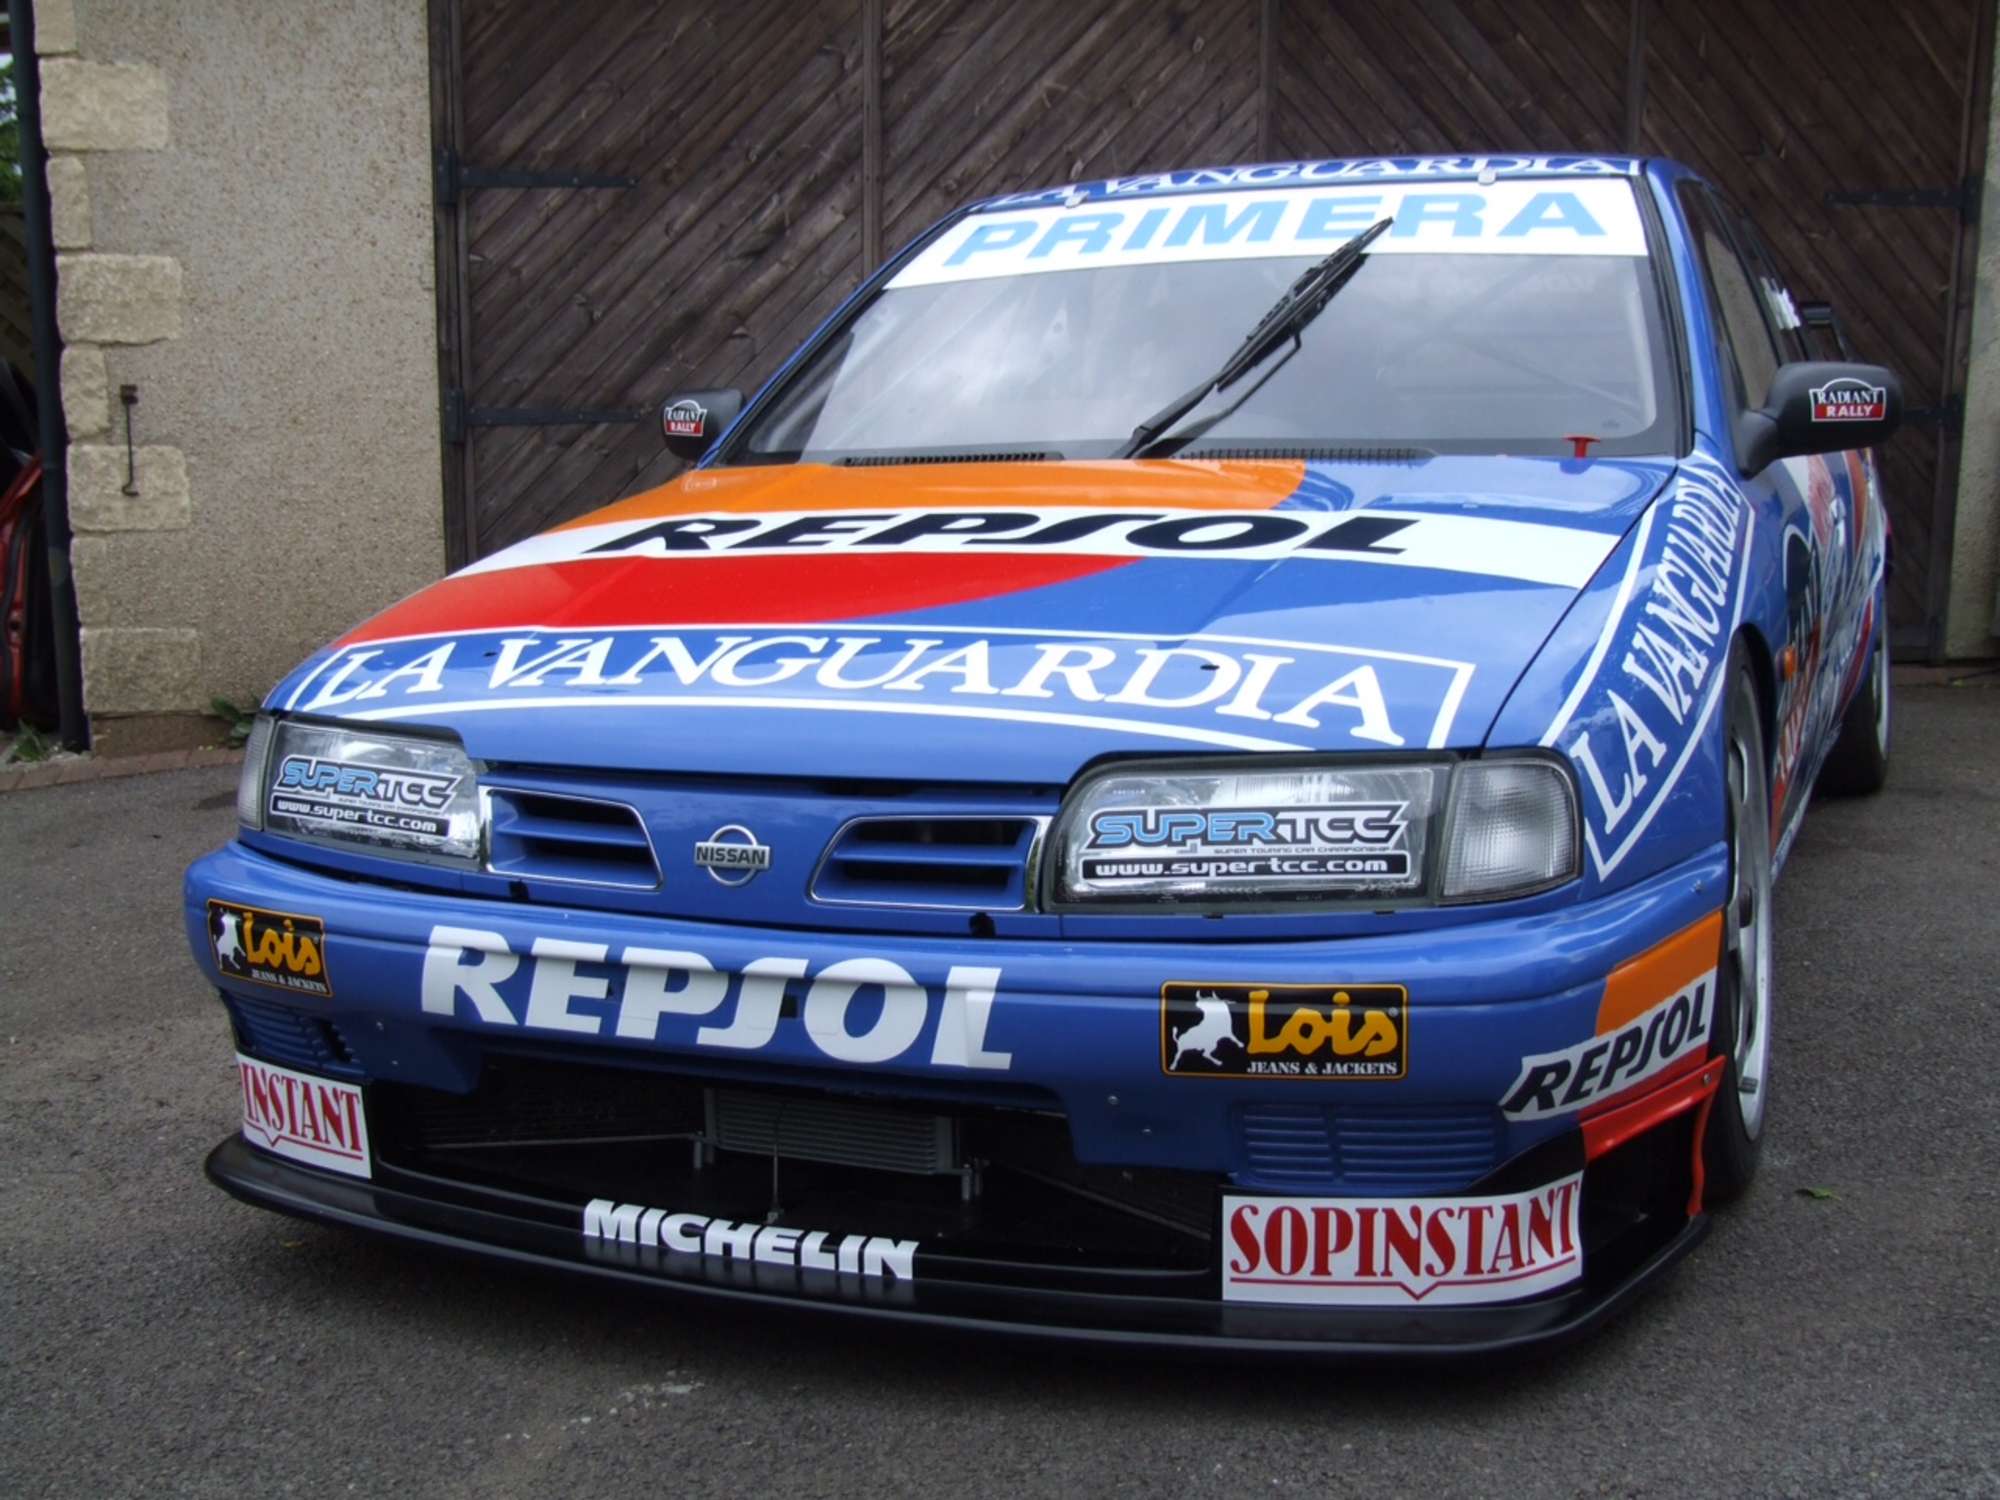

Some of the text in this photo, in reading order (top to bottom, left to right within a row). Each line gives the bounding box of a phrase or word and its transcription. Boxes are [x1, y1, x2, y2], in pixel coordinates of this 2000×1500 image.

[1105, 157, 1624, 195] VANGUARDIA
[943, 191, 1608, 267] PRIMERA
[1826, 405, 1873, 417] RALLY
[580, 512, 1421, 555] REPSOL
[1571, 465, 1741, 834] LA VANGUARDIA
[303, 636, 1406, 747] LA VANGUARDIA
[277, 799, 438, 833] www.supertcc.com
[696, 846, 766, 865] NISSAN
[1095, 857, 1389, 878] www.supertcc.com
[421, 925, 1013, 1070] REPSOL
[1247, 1061, 1397, 1075] JEANS & JACKETS
[1502, 982, 1706, 1113] REPSOL
[584, 1198, 920, 1280] MICHELIN
[1229, 1179, 1579, 1277] SOPINSTANT
